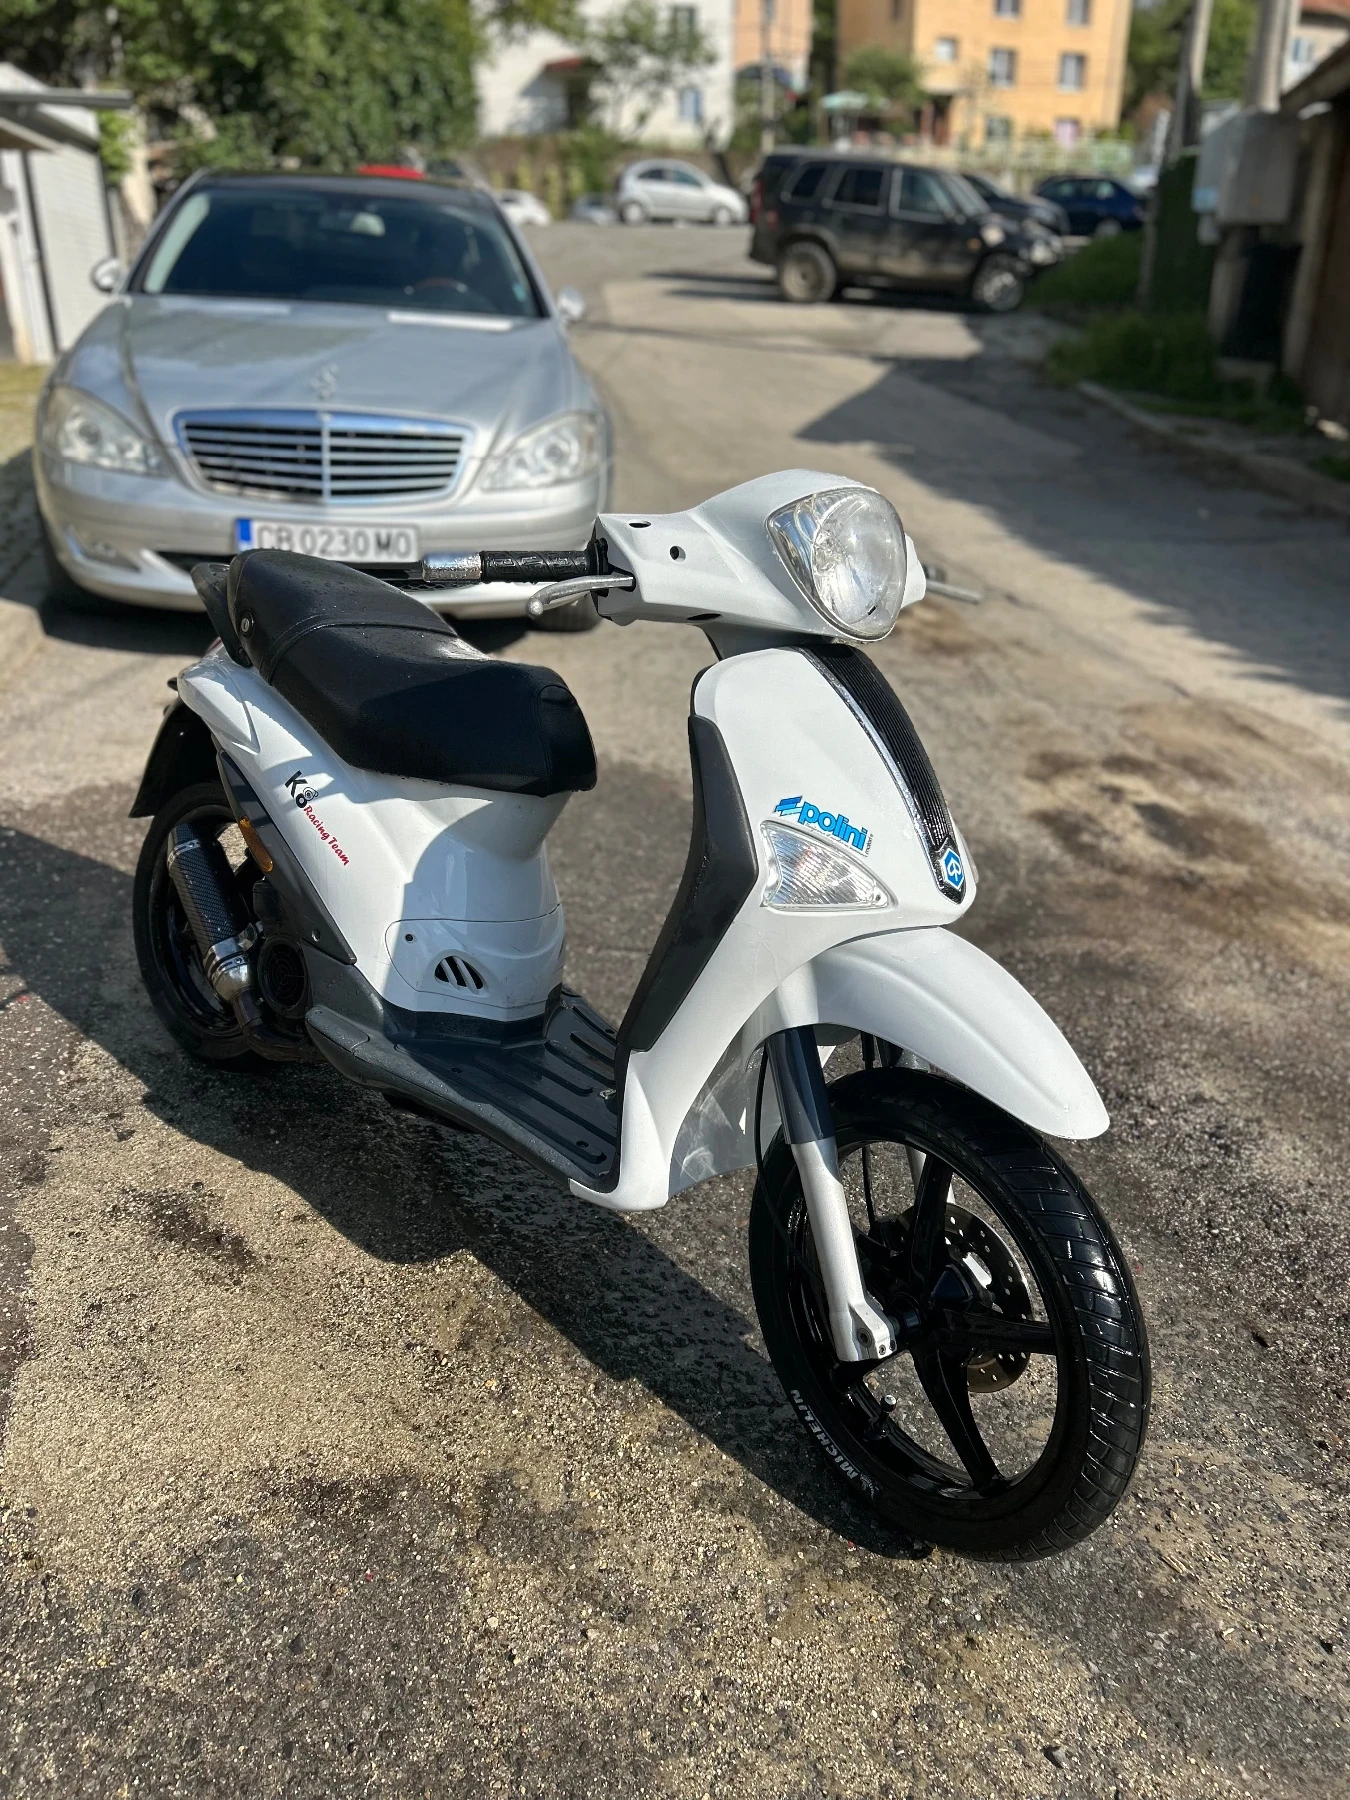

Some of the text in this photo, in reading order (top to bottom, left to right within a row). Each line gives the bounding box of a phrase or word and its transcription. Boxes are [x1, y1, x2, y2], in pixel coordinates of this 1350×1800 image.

[257, 525, 412, 559] CB 0230 MO
[304, 805, 349, 866] Racing Team
[798, 801, 868, 851] polini
[791, 1389, 858, 1479] MICHELIN
